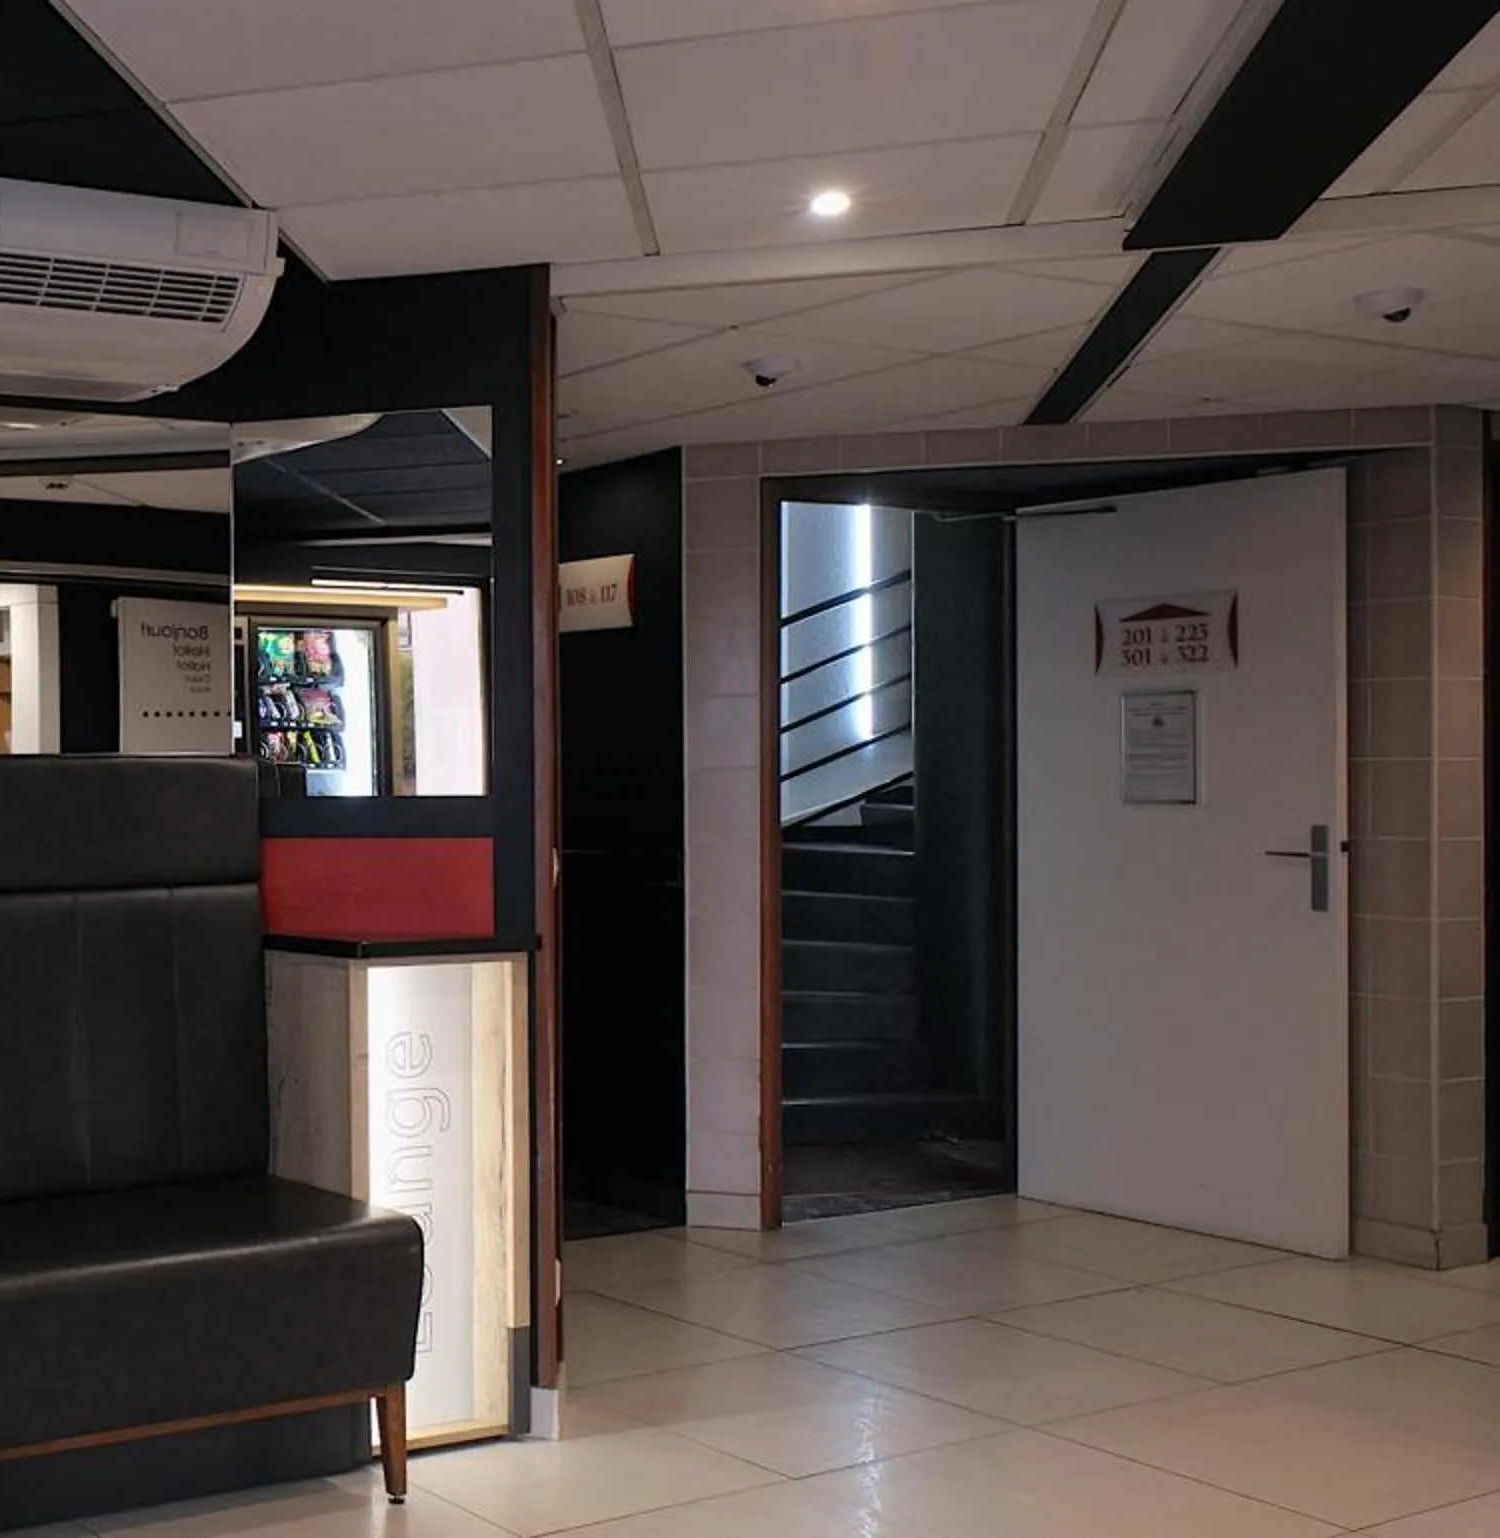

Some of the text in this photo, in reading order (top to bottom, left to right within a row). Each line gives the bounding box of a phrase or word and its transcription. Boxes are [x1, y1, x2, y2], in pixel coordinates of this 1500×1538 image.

[600, 583, 617, 602] 117
[1122, 626, 1152, 646] 201
[1121, 648, 1151, 668] 301
[384, 1030, 451, 1353] nge
